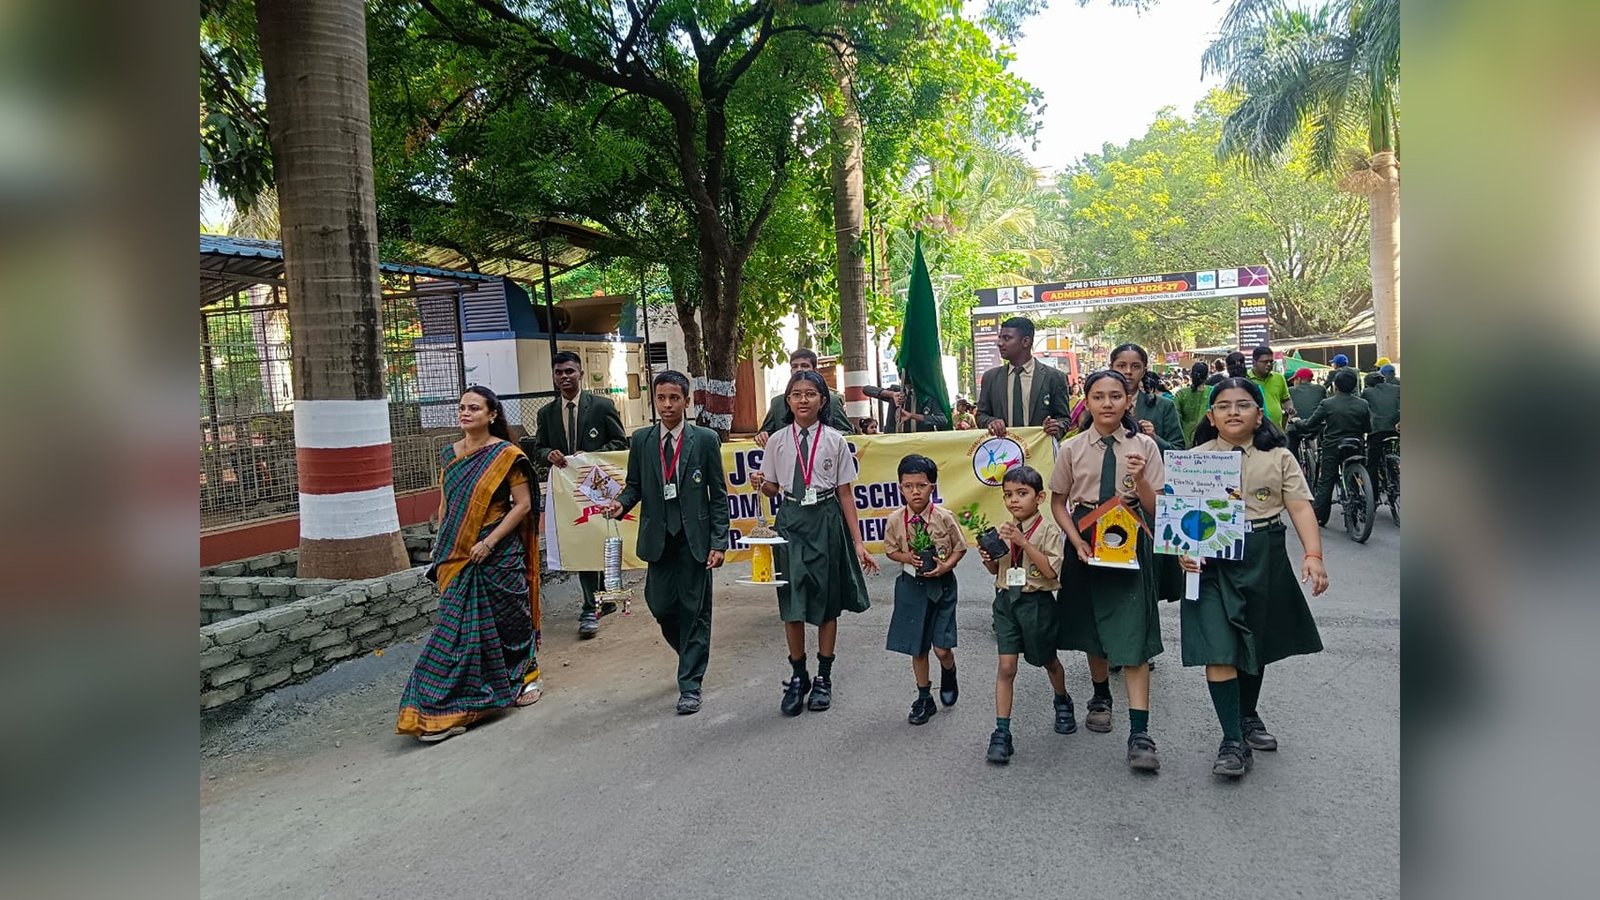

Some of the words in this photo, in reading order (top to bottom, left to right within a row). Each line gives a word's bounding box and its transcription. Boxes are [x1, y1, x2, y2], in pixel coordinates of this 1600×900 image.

[1063, 281, 1083, 290] JSPM
[1089, 279, 1108, 288] TSSM
[1108, 277, 1133, 286] NARHE
[1133, 275, 1163, 284] CAMPUS
[1050, 287, 1109, 300] ADMISSIONS
[1111, 286, 1138, 295] OPEN
[1140, 283, 1179, 293] 2026-27
[1241, 298, 1266, 307] TSSM
[976, 319, 996, 327] JSPM
[854, 483, 943, 510] SCHL
